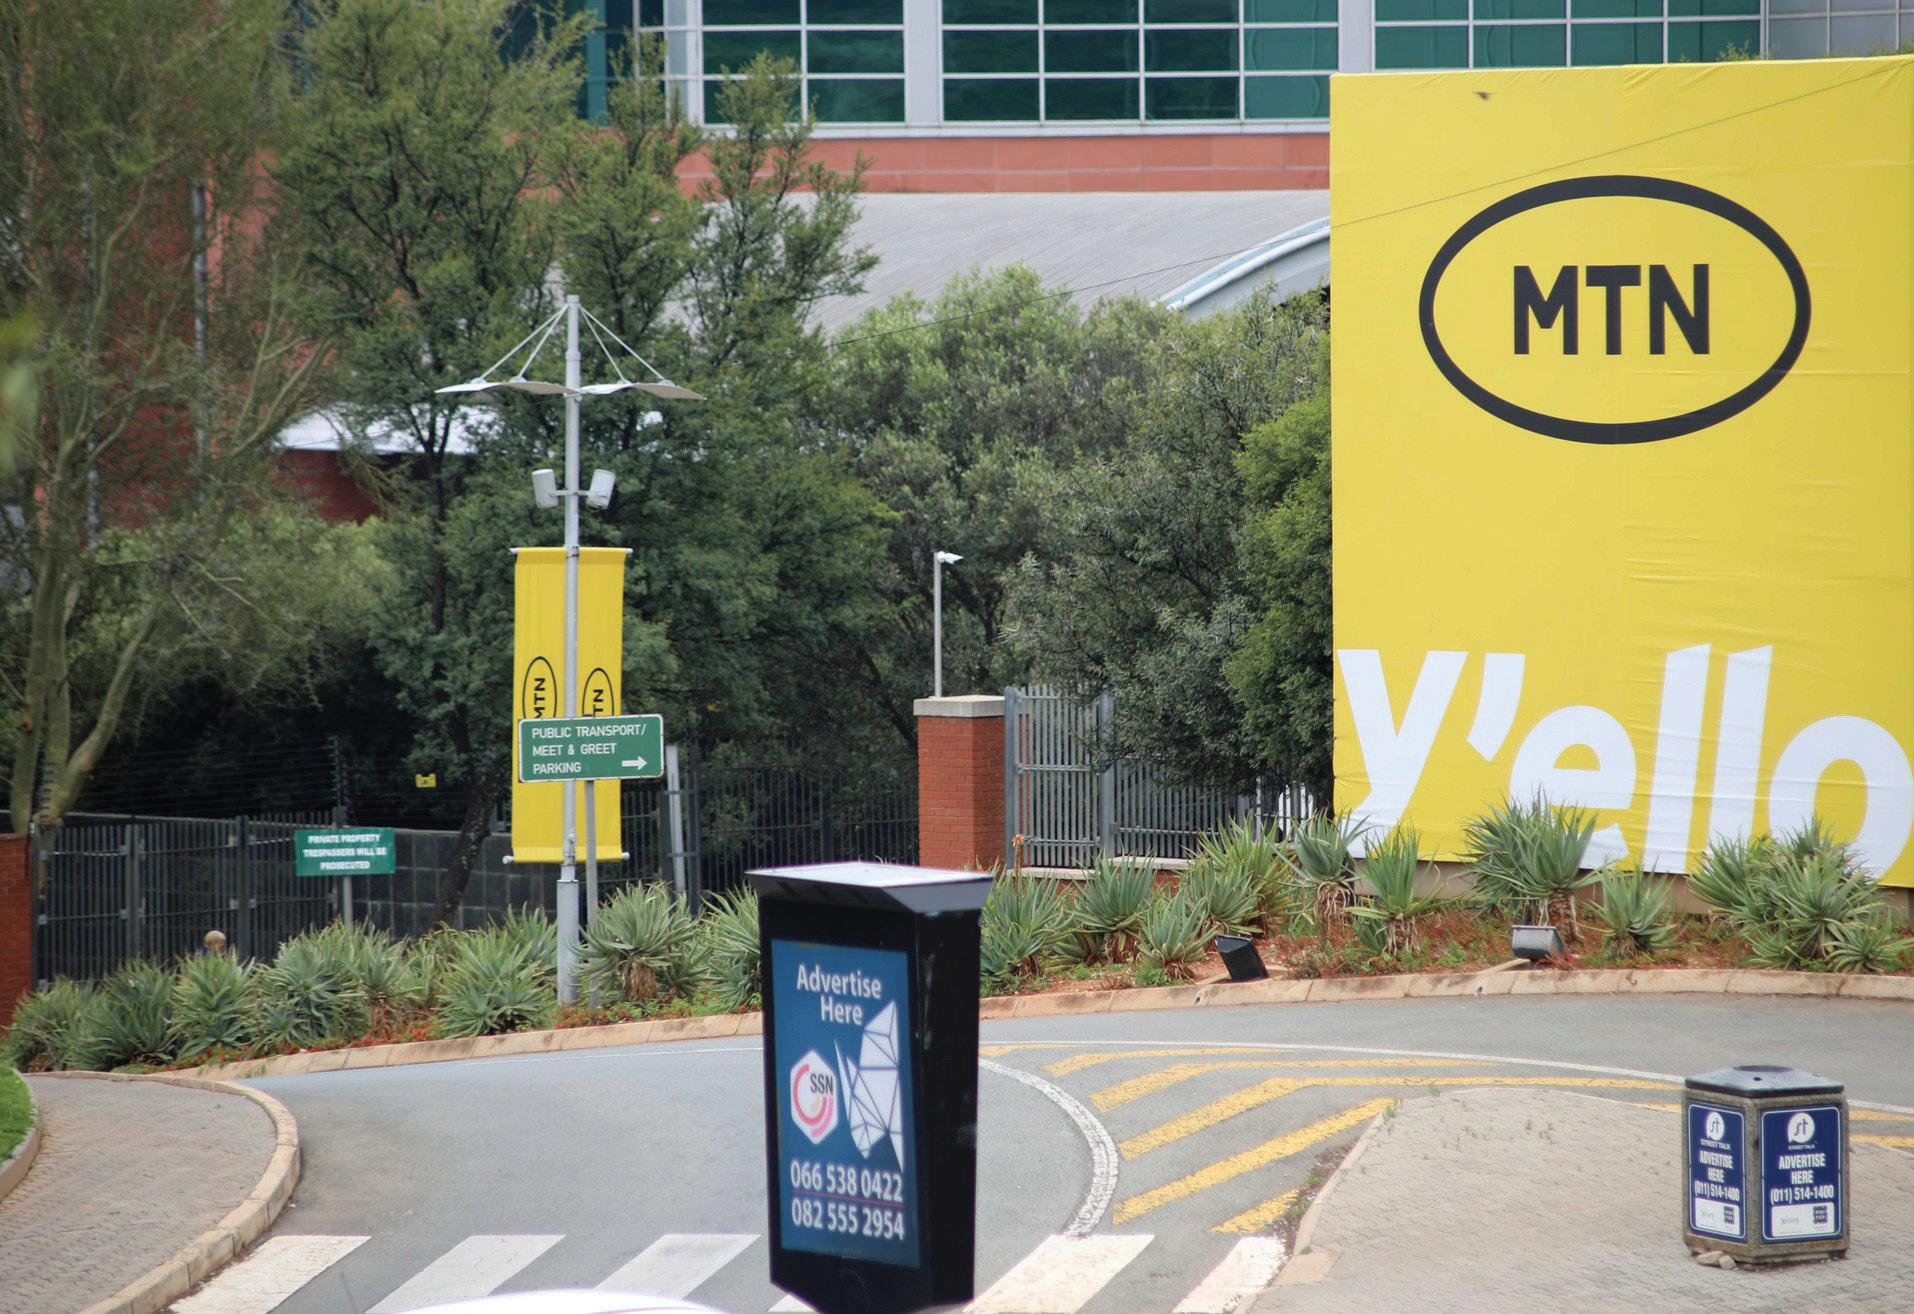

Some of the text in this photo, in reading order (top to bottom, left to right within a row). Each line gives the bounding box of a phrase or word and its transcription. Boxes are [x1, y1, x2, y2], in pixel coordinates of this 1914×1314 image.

[1513, 263, 1710, 356] MTN
[593, 689, 605, 717] TN
[532, 724, 647, 739] PUBLIC TRANSPORT/
[532, 742, 617, 757] MEET & GREET
[533, 762, 582, 775] PARKING
[1337, 644, 1914, 888] y'ello
[796, 964, 882, 999] Advertise
[820, 996, 863, 1025] Here
[810, 1074, 834, 1096] SSN
[1699, 1150, 1734, 1169] ADVERTISE
[1779, 1153, 1826, 1170] ADVERTISE
[790, 1159, 904, 1204] 066 538 0422
[1708, 1169, 1725, 1183] HERE
[1791, 1170, 1814, 1185] HERE
[1694, 1180, 1740, 1202] (011) 514-1400
[1770, 1185, 1834, 1205] (011) 514-1400
[791, 1198, 905, 1241] 082 555 2954
